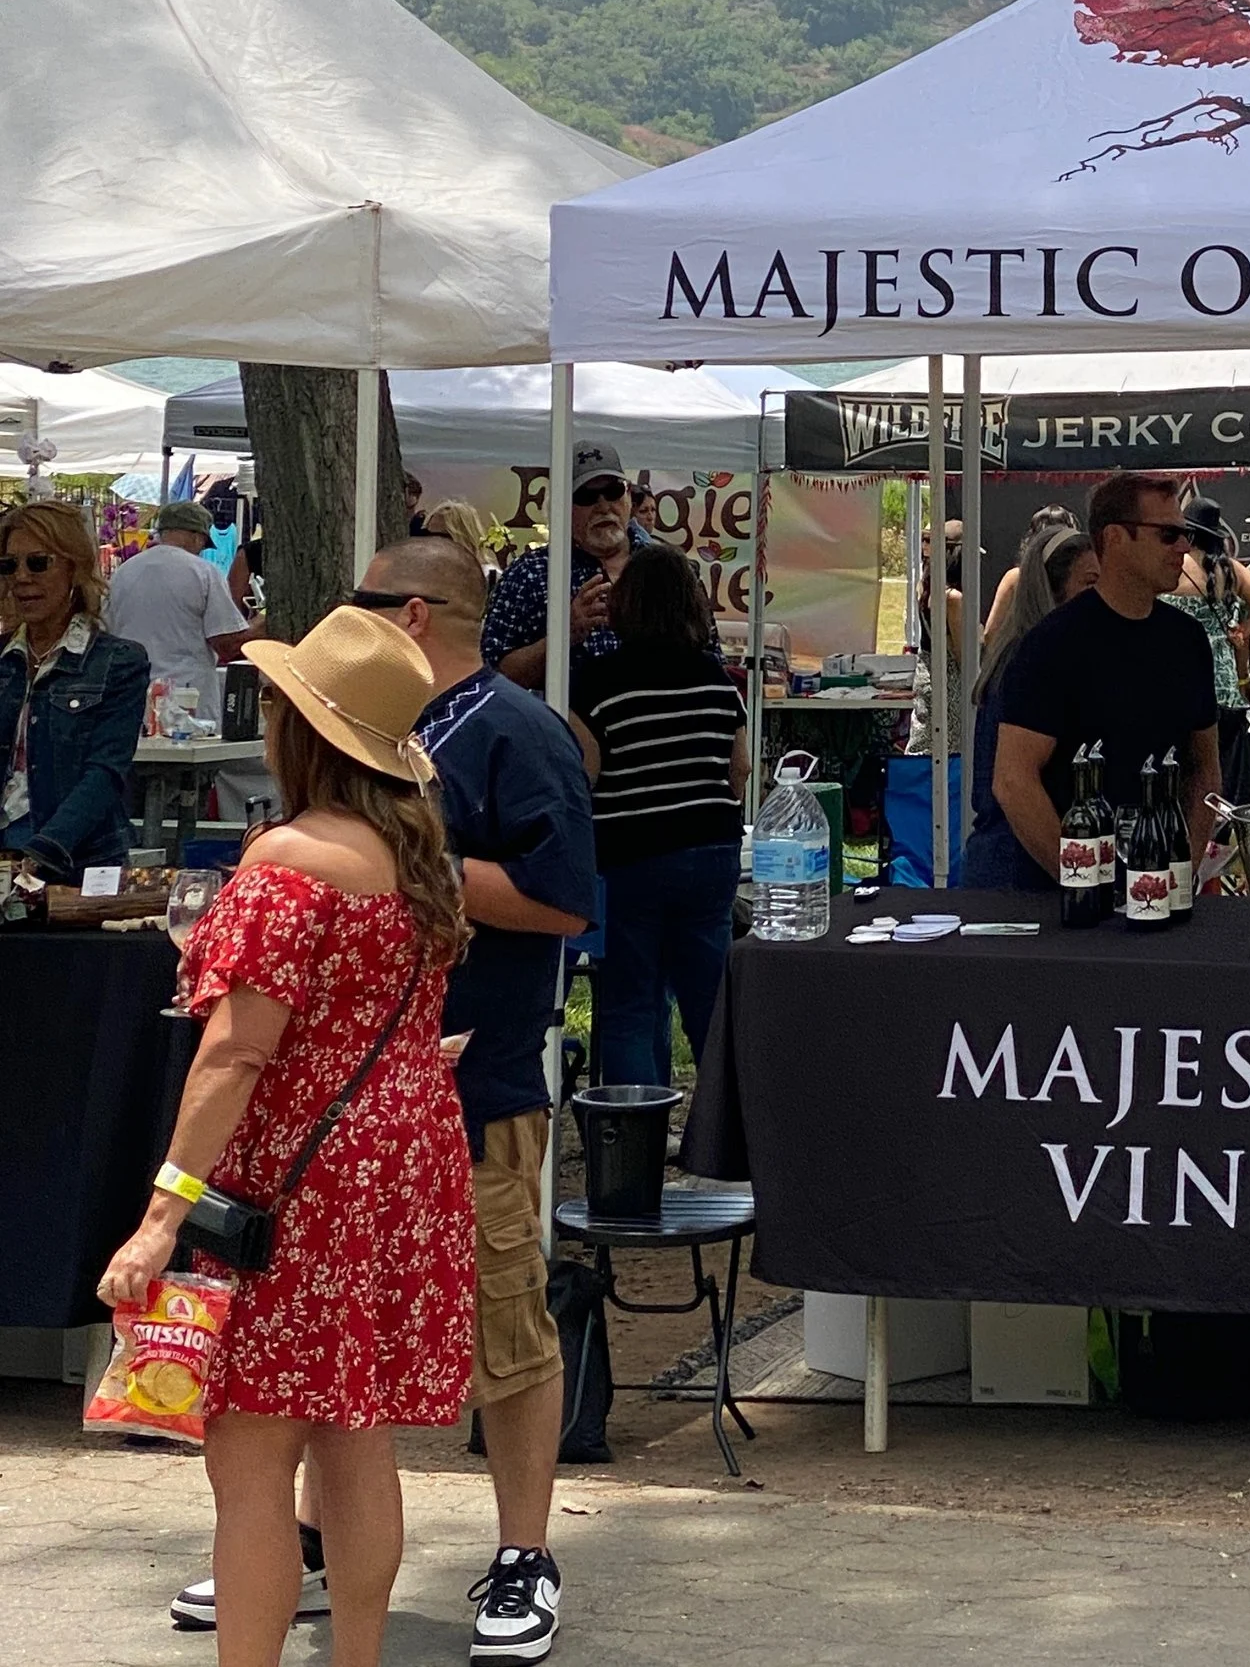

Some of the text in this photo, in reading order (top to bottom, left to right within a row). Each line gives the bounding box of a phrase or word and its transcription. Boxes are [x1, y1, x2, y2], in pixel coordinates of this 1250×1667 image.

[658, 247, 1139, 337] MAJESTIC
[845, 401, 1004, 459] WILDIE
[1022, 414, 1193, 447] JERKY
[504, 466, 752, 553] Fgie
